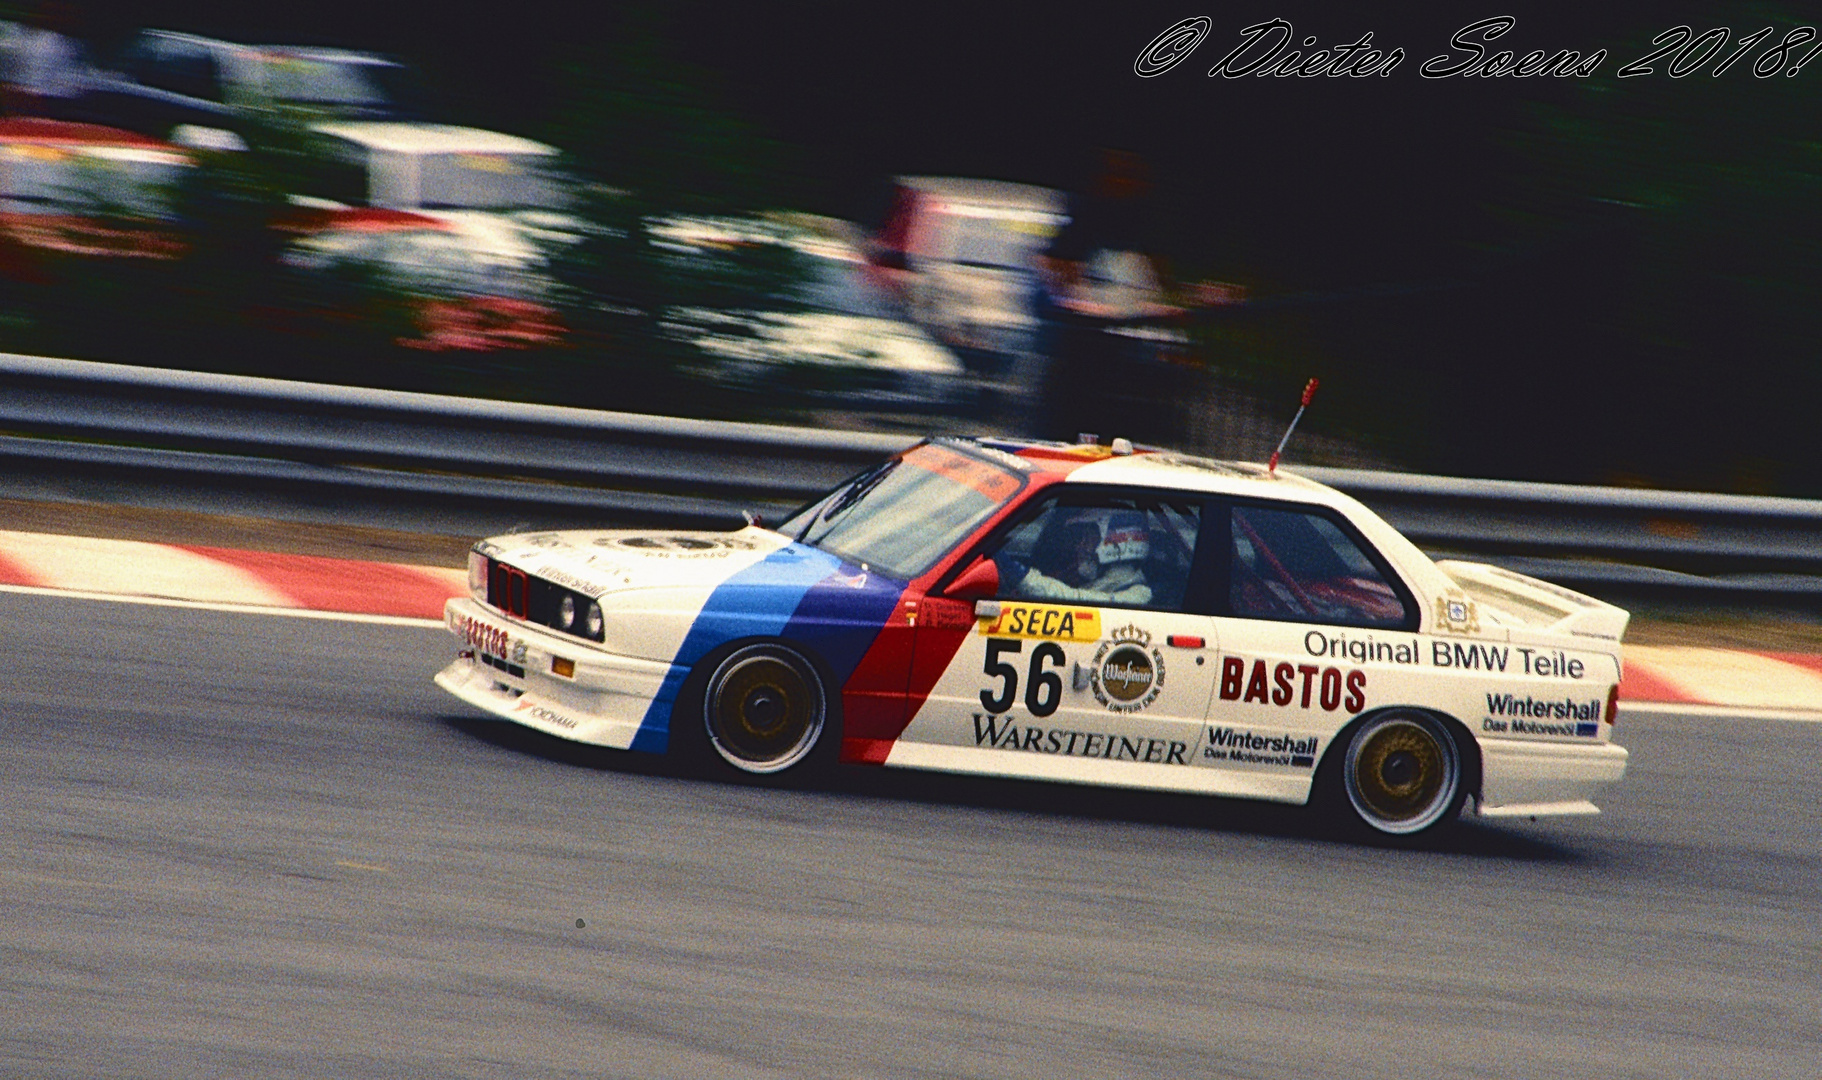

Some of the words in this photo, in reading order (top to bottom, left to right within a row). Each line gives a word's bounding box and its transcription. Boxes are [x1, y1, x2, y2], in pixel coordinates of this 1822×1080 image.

[1009, 607, 1074, 637] SECA
[1304, 630, 1419, 664] Original
[1432, 640, 1508, 672] BMW
[1516, 647, 1585, 679] Teile
[980, 637, 1066, 717] 56
[1219, 656, 1366, 714] BASTOS
[1485, 693, 1600, 722] Wintershall
[972, 713, 1188, 765] WARSTEINER
[1483, 718, 1508, 732] Das
[1204, 746, 1227, 759] Das
[1208, 726, 1317, 755] Wintershall
